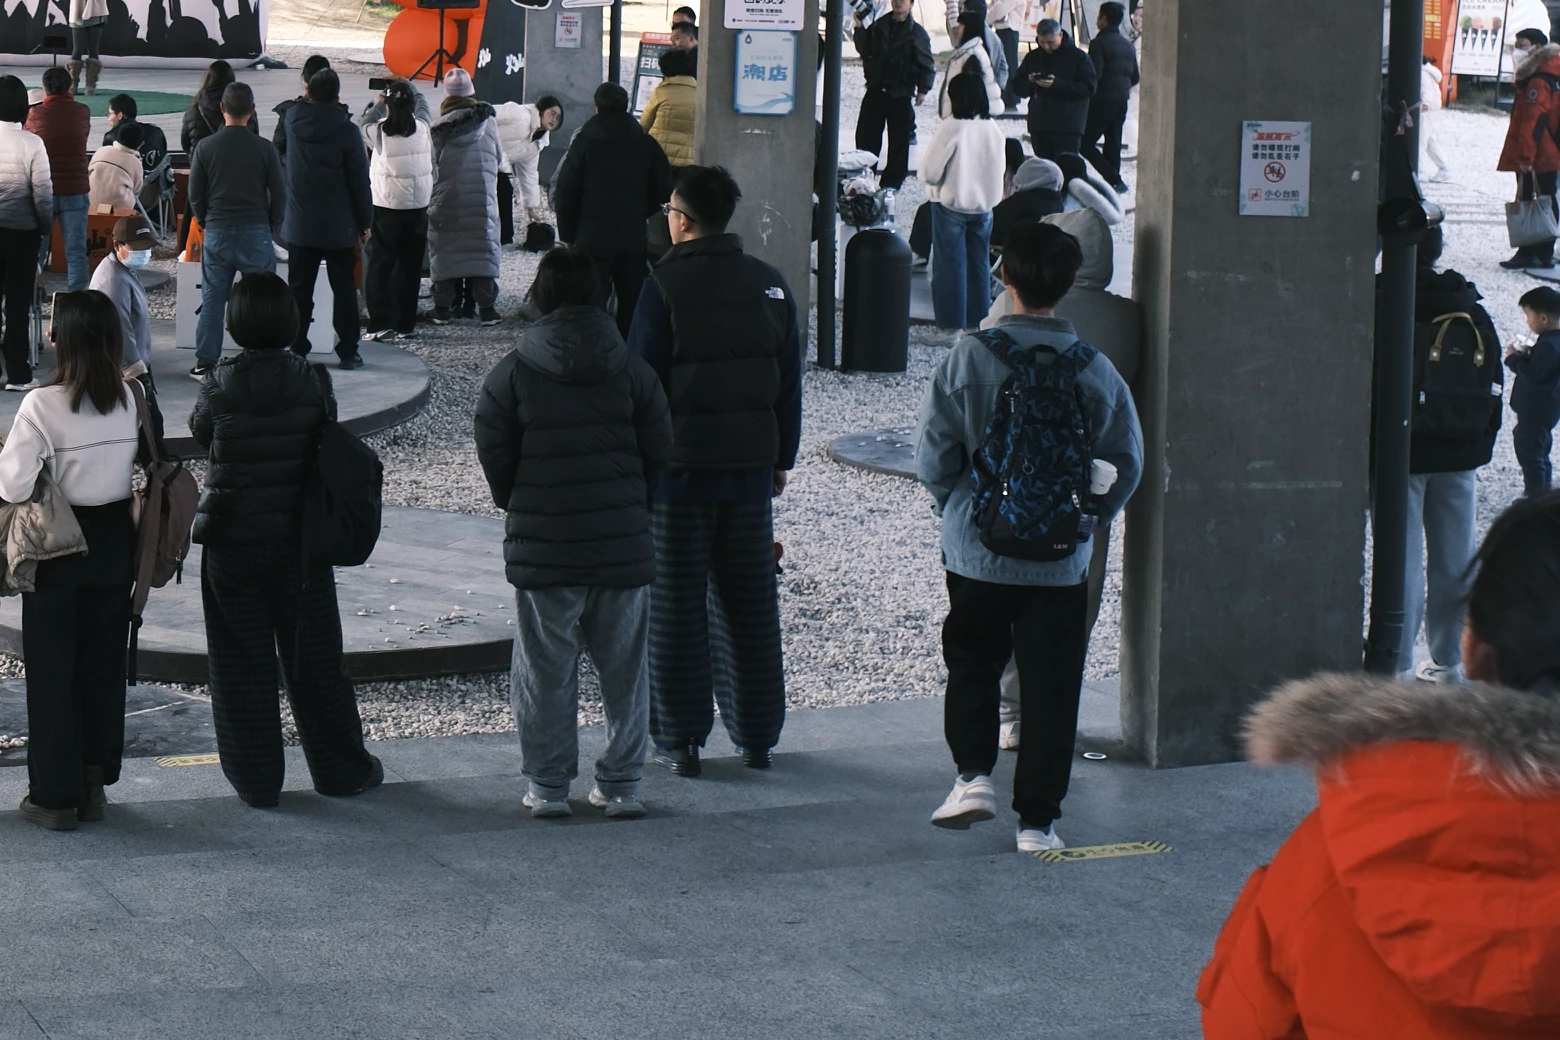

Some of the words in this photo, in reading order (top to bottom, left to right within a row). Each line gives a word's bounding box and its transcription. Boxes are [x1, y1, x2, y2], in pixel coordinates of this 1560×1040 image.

[742, 63, 789, 82] 潮店
[1264, 189, 1300, 199] 小心台阶
